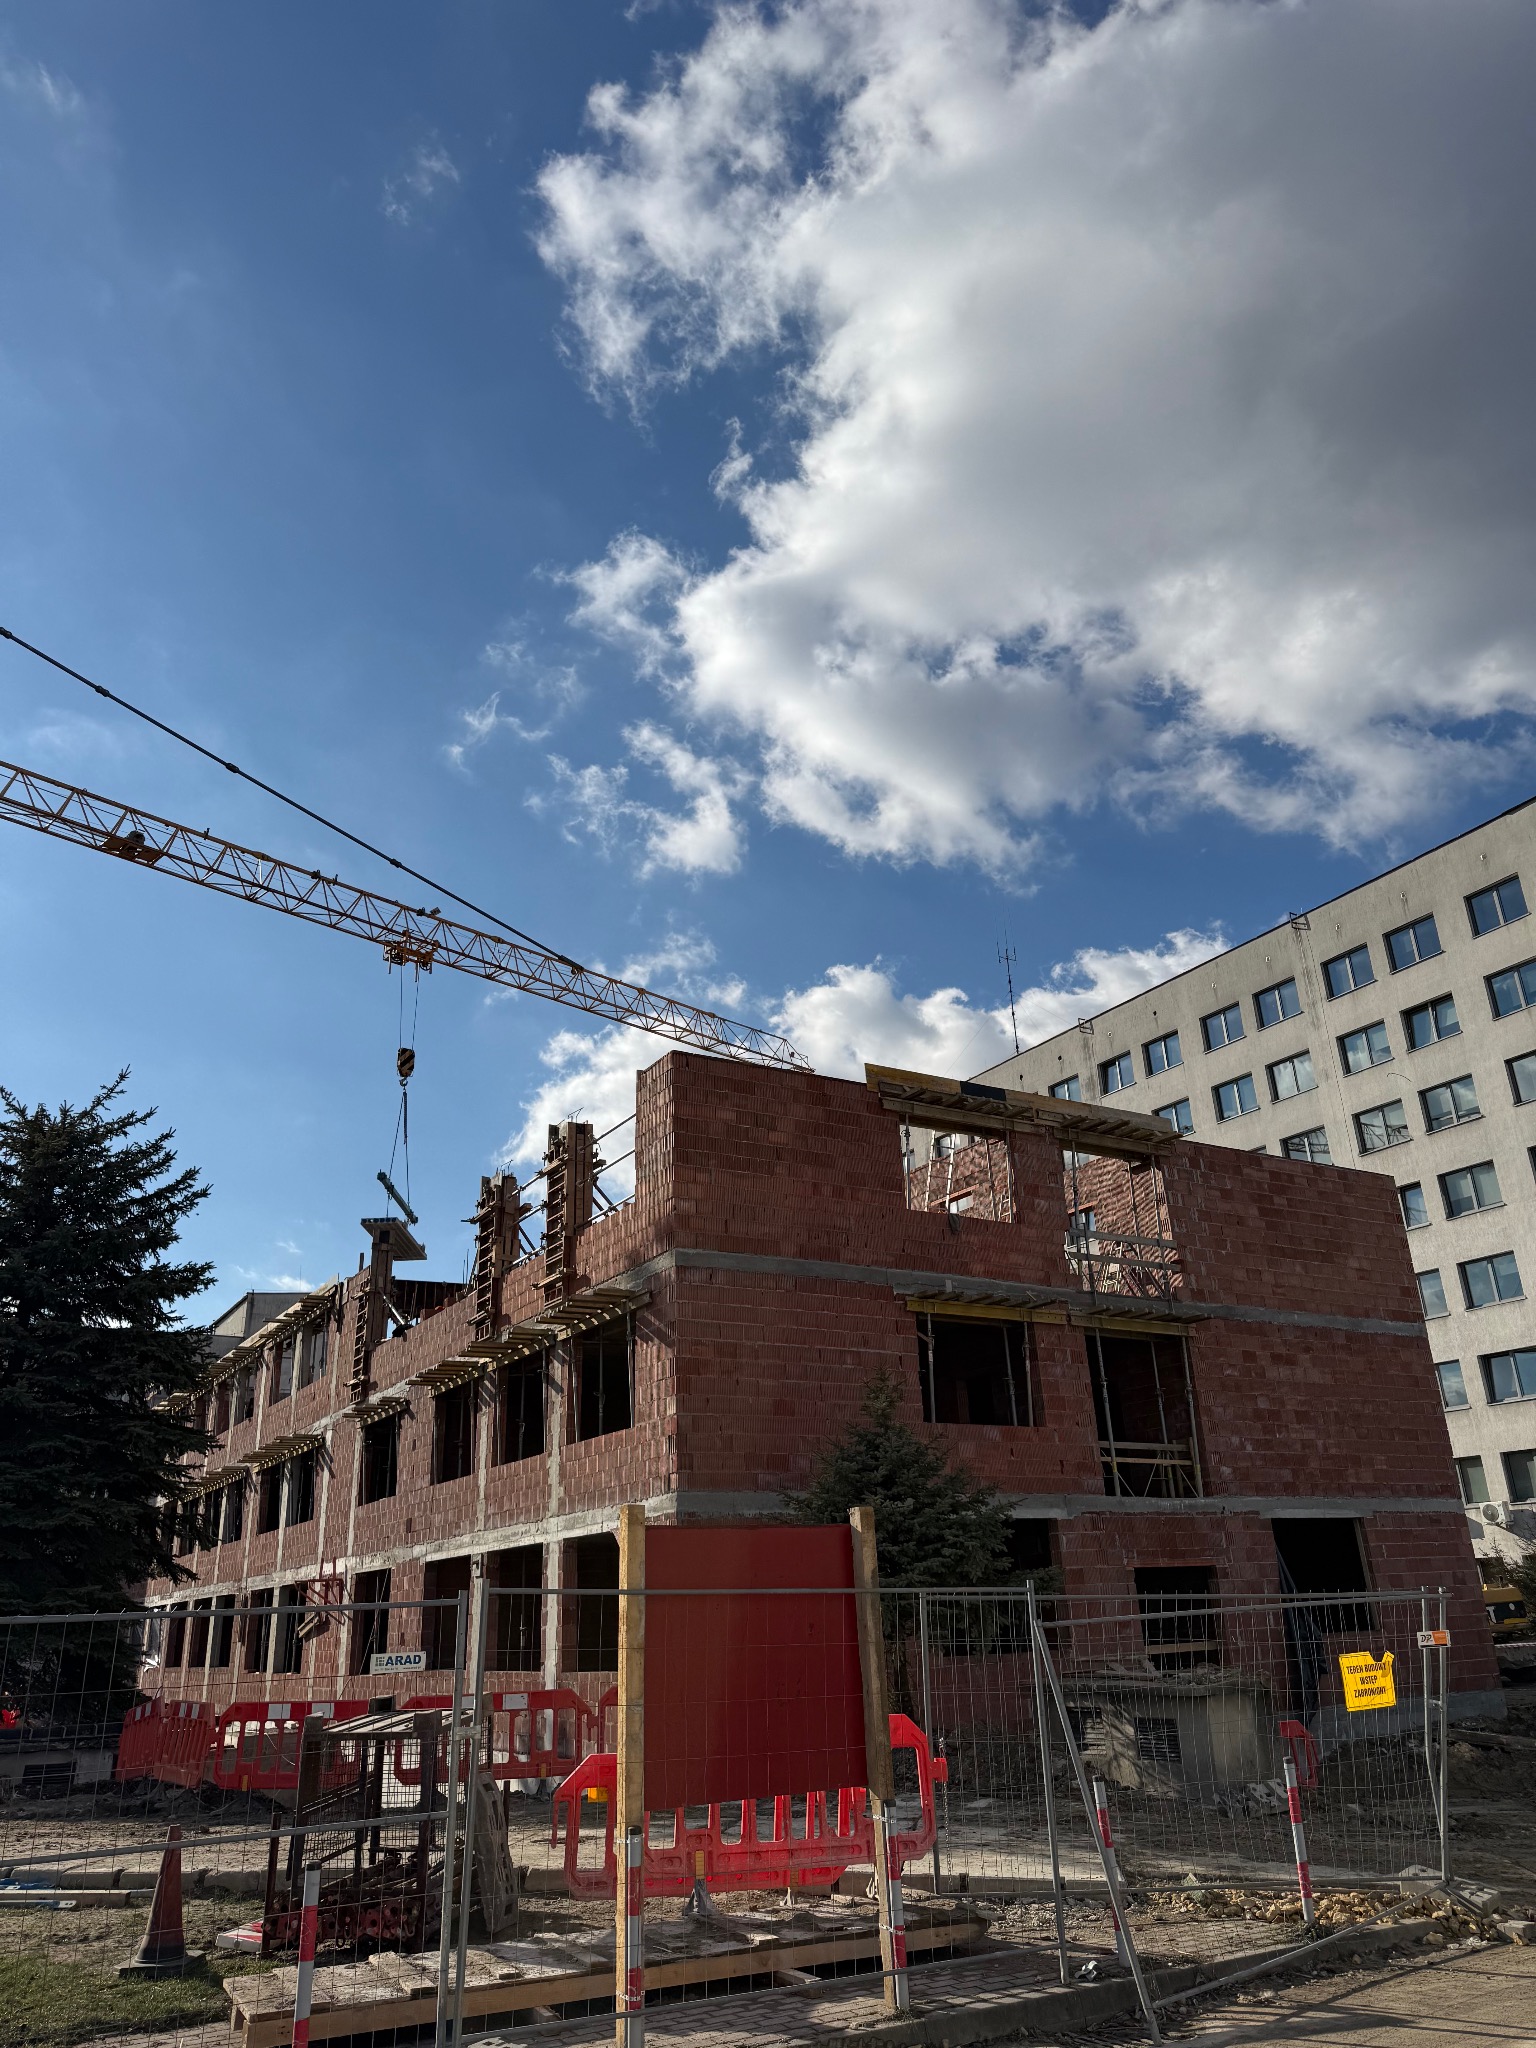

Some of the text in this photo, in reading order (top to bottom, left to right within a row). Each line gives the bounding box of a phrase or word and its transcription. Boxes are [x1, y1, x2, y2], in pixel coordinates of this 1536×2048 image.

[385, 1655, 421, 1666] ARAD
[1346, 1662, 1387, 1674] TEREN BUDOWY
[1360, 1675, 1377, 1685] WSTĘP
